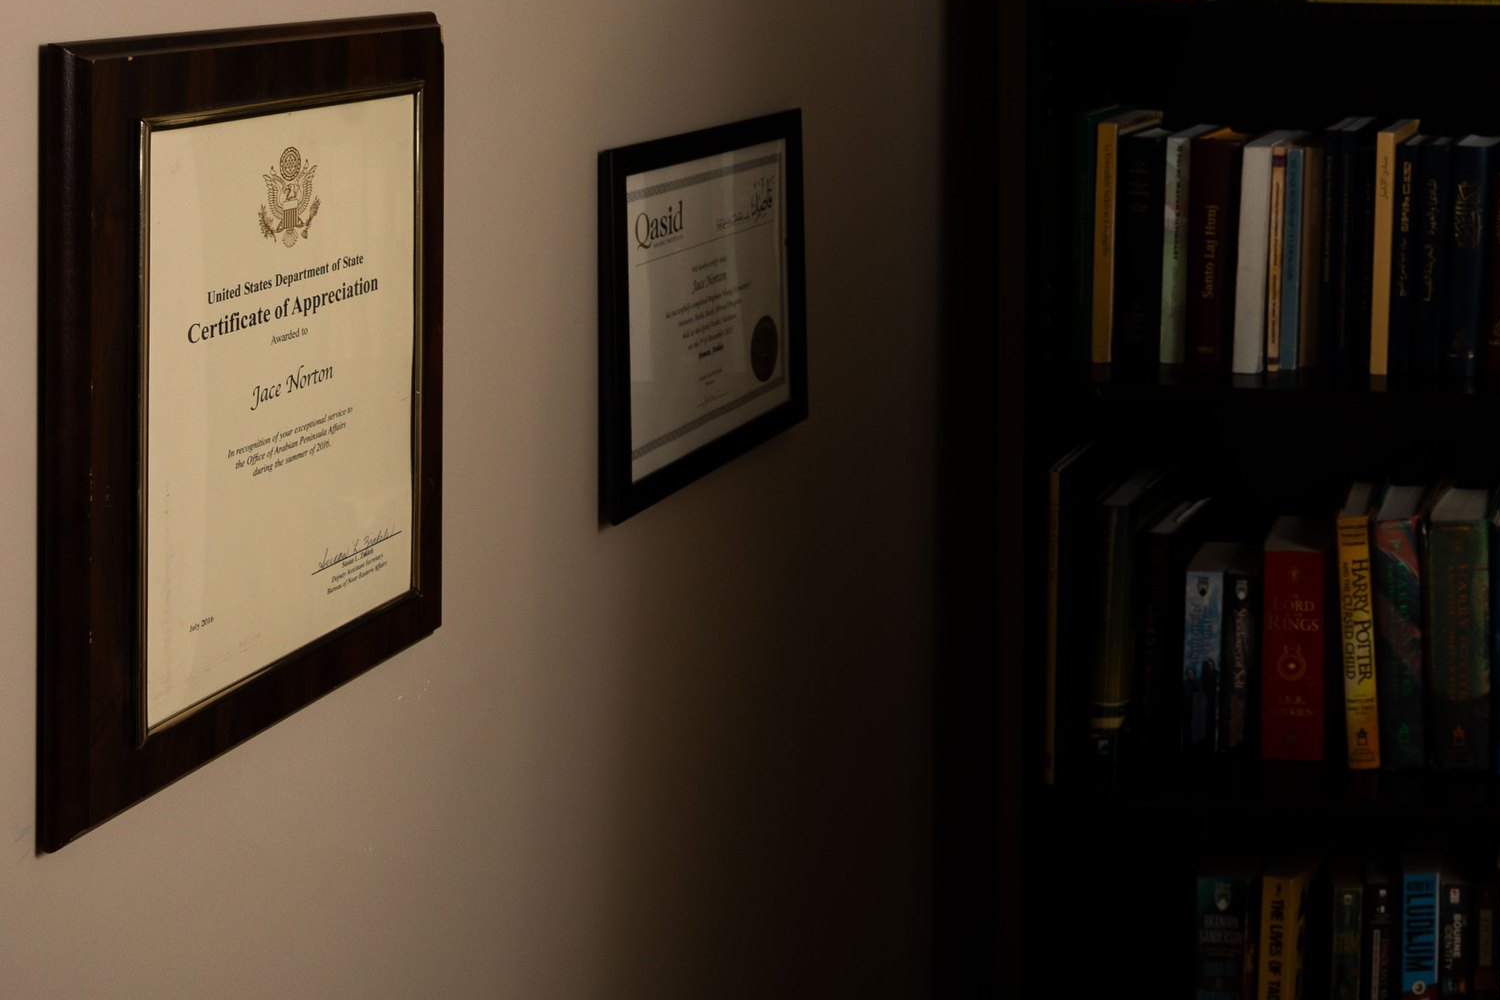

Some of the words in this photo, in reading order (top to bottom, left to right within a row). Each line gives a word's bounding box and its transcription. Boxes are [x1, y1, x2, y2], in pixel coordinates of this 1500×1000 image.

[635, 200, 684, 250] Qasid
[1205, 203, 1221, 235] Huuj
[1203, 235, 1219, 256] Laj
[207, 284, 241, 305] United
[243, 278, 272, 296] States
[275, 262, 329, 288] Department
[331, 258, 342, 272] of
[342, 254, 364, 269] State
[1201, 257, 1215, 299] Santo
[187, 306, 271, 344] Certificate
[274, 297, 290, 320] of
[291, 277, 379, 317] Appreciation
[271, 328, 300, 345] Awarded
[301, 326, 309, 336] to
[250, 383, 282, 411] Jace
[285, 364, 334, 393] Norton
[227, 449, 235, 459] In
[235, 437, 271, 456] recognition
[271, 431, 280, 443] of
[279, 428, 293, 442] your
[293, 414, 327, 434] exceptional
[327, 408, 347, 421] service
[347, 406, 353, 414] to
[235, 460, 245, 470] the
[246, 451, 266, 466] Office
[266, 448, 274, 459] of
[273, 440, 299, 455] Arabian
[299, 428, 327, 446] Peninsula
[327, 421, 347, 436] Affairs
[252, 463, 273, 477] during
[274, 458, 284, 468] the
[285, 449, 308, 464] summer
[308, 444, 316, 456] of
[1270, 595, 1316, 613] LORD
[1343, 578, 1351, 593] THE
[1351, 558, 1370, 617] HARRY
[1457, 563, 1470, 630] HARRY
[1267, 614, 1321, 634] RINGS
[1343, 593, 1355, 640] CURSED
[1345, 642, 1356, 680] CHILD
[1354, 618, 1373, 686] POTTER
[1458, 635, 1470, 702] POTTER
[1271, 899, 1285, 920] THE
[1269, 924, 1283, 957] LIVES
[1405, 893, 1434, 973] LUDLUM
[1444, 924, 1453, 971] IDENTITY
[1452, 913, 1463, 959] BOURNE
[1268, 960, 1281, 976] OF
